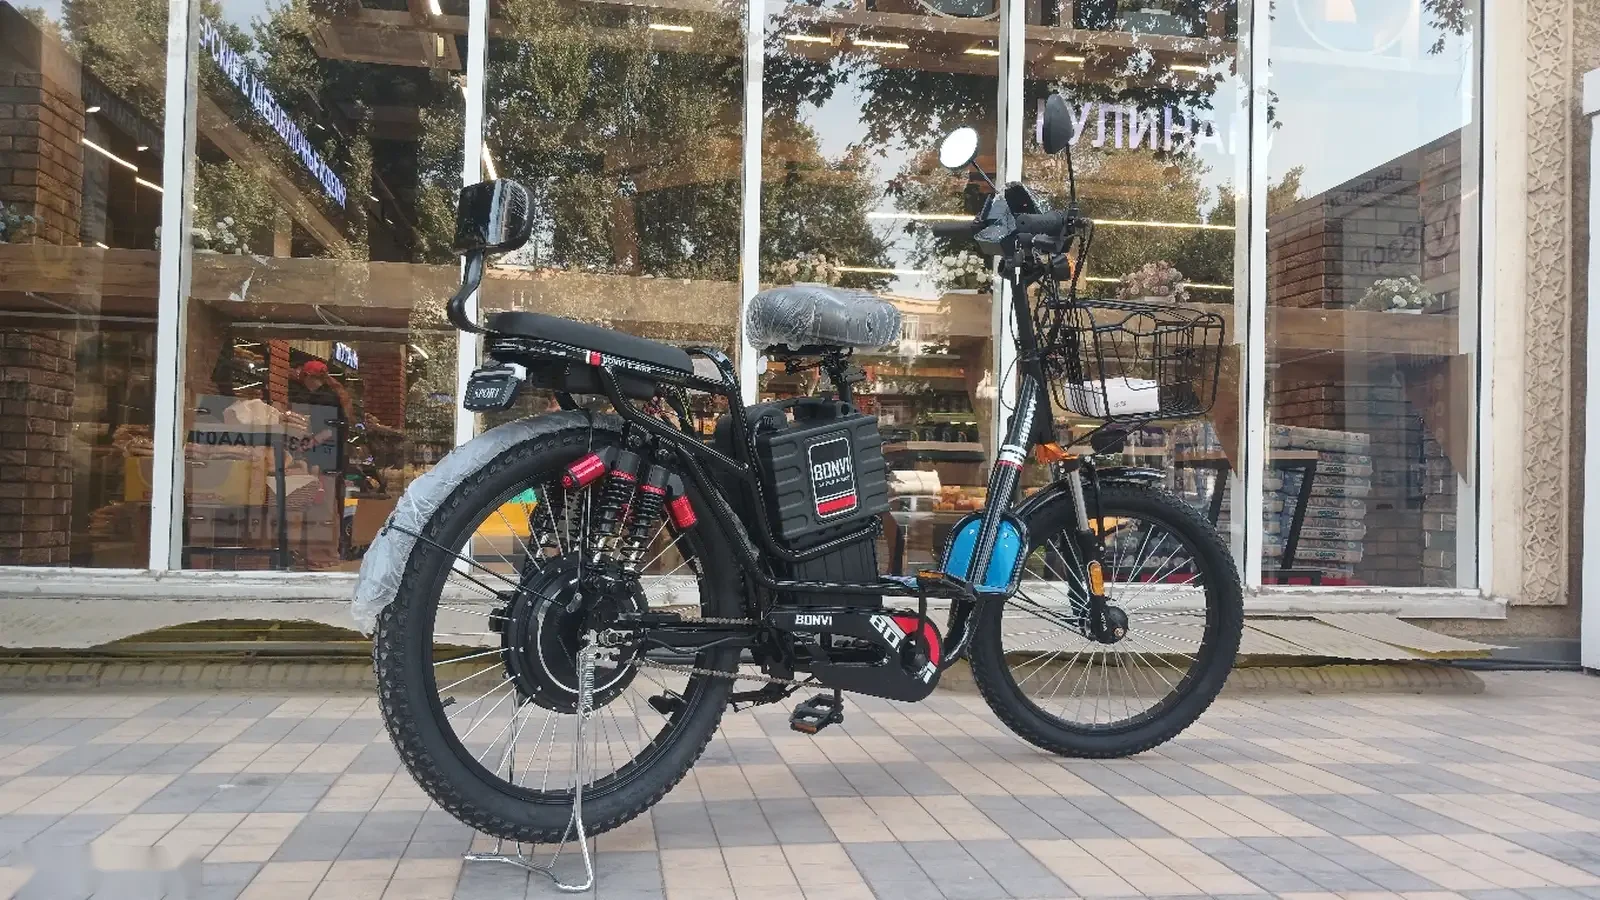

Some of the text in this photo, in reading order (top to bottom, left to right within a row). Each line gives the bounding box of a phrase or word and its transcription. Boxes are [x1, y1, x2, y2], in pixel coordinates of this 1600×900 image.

[472, 387, 502, 399] SPORT
[813, 457, 851, 481] BONVI
[795, 614, 833, 626] BONVI
